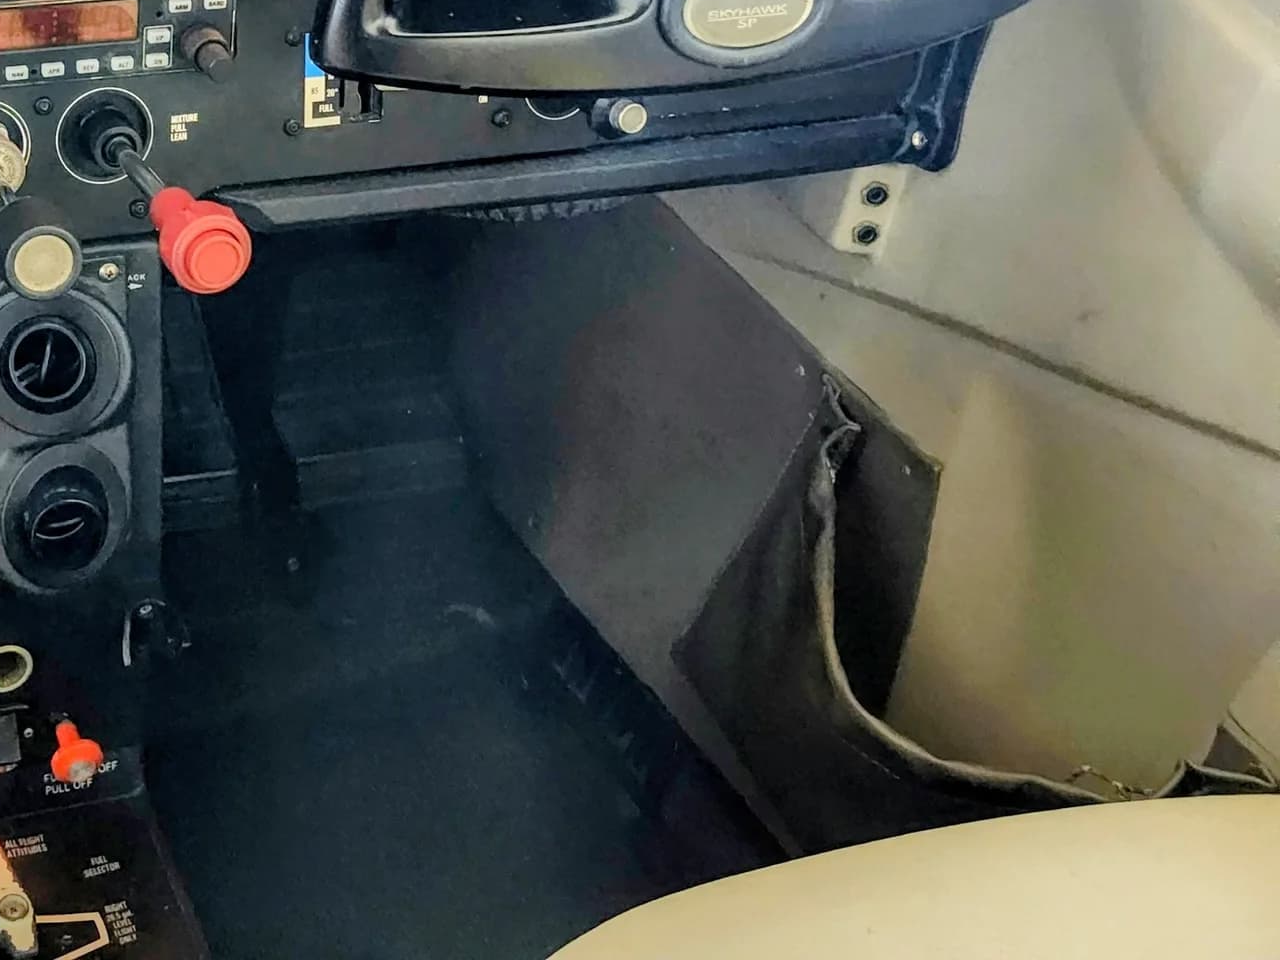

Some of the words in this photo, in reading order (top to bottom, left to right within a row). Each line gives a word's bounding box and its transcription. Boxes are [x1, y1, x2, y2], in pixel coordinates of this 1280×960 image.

[707, 3, 788, 19] SKYHAWK
[737, 18, 758, 29] SP
[318, 103, 335, 113] FULL
[170, 113, 198, 123] MIXTURE
[171, 123, 187, 132] PULL
[171, 132, 187, 142] LEAN
[45, 782, 71, 796] PULL
[73, 778, 94, 790] OFF
